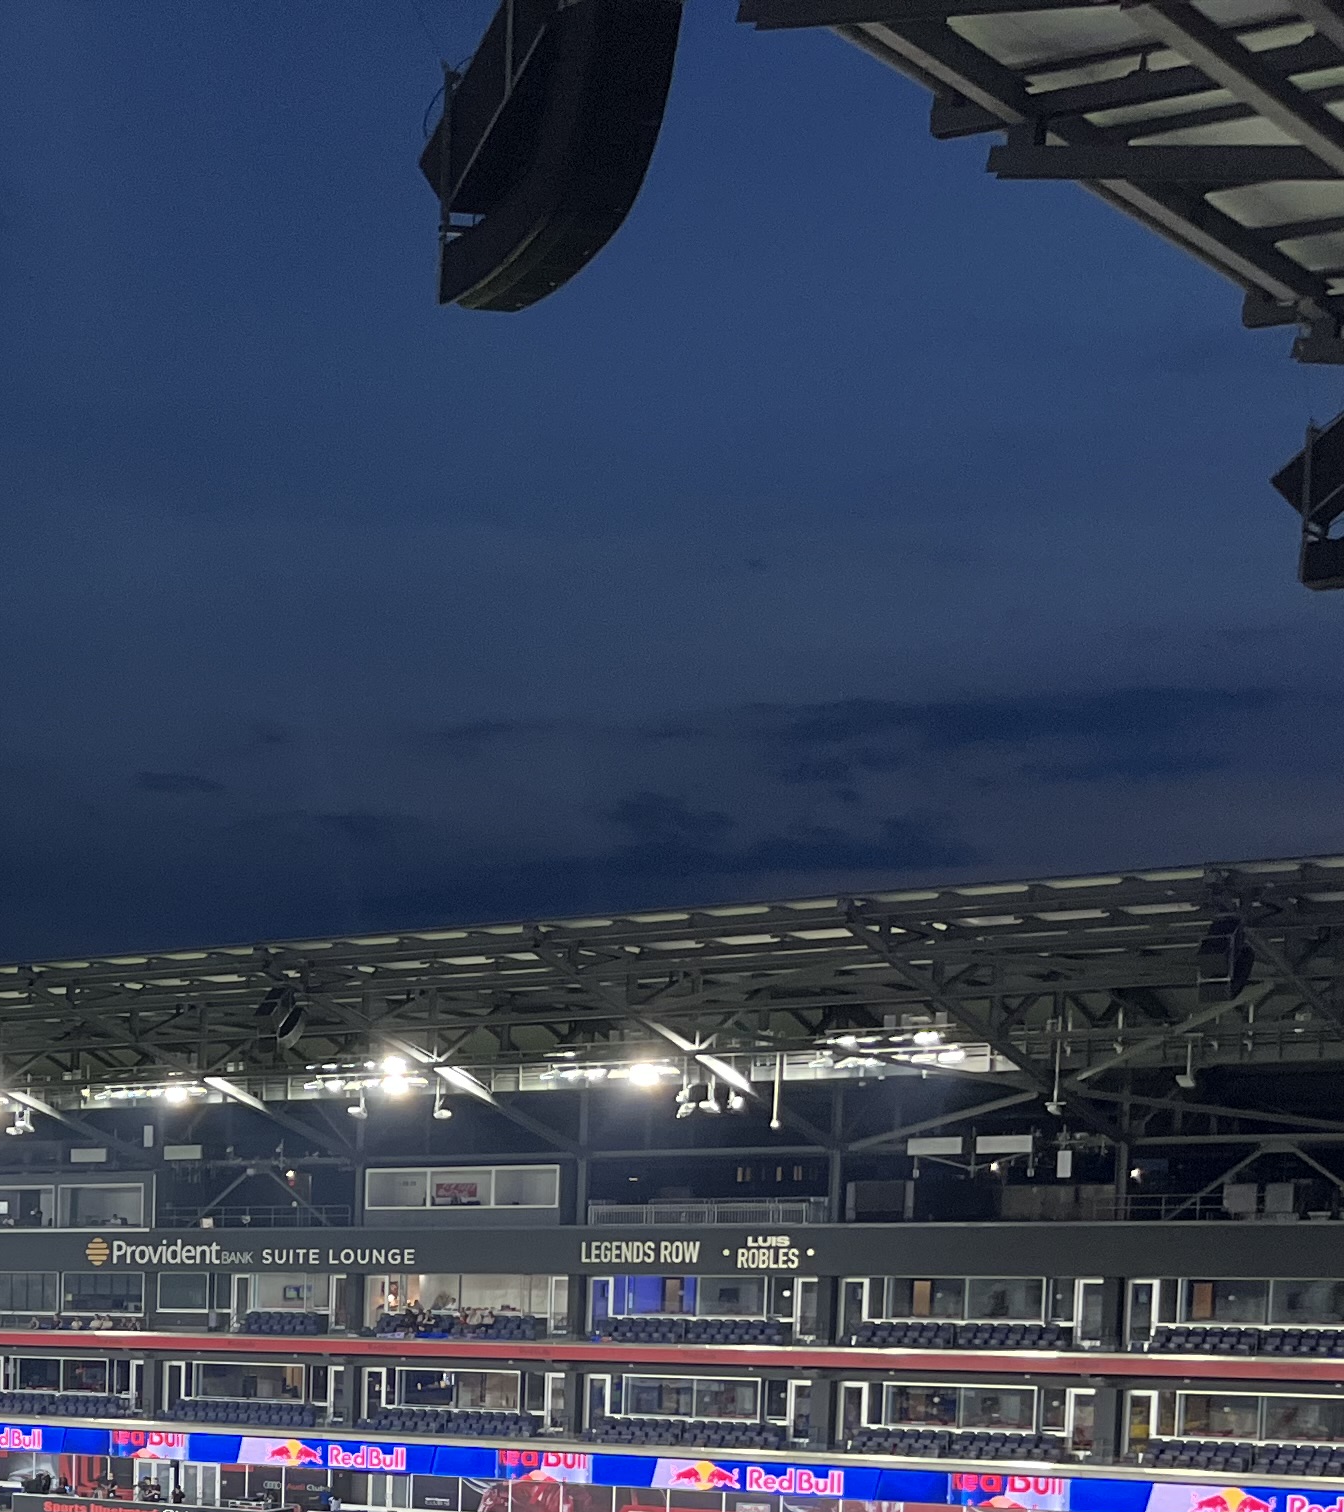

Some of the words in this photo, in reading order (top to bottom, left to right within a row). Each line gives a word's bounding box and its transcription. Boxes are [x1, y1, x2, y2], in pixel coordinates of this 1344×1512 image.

[113, 1239, 220, 1264] Provident
[221, 1251, 253, 1264] BANK
[262, 1249, 320, 1265] SUITE
[329, 1249, 415, 1265] LOUNGE
[581, 1241, 655, 1263] LEGENDS
[660, 1241, 700, 1263] ROW
[747, 1236, 790, 1247] LUIS
[737, 1248, 799, 1269] ROBLES
[10, 1428, 42, 1449] Bull
[328, 1445, 367, 1468] Red
[368, 1446, 406, 1470] Bull
[746, 1466, 796, 1493] Red
[797, 1470, 844, 1496] Bull
